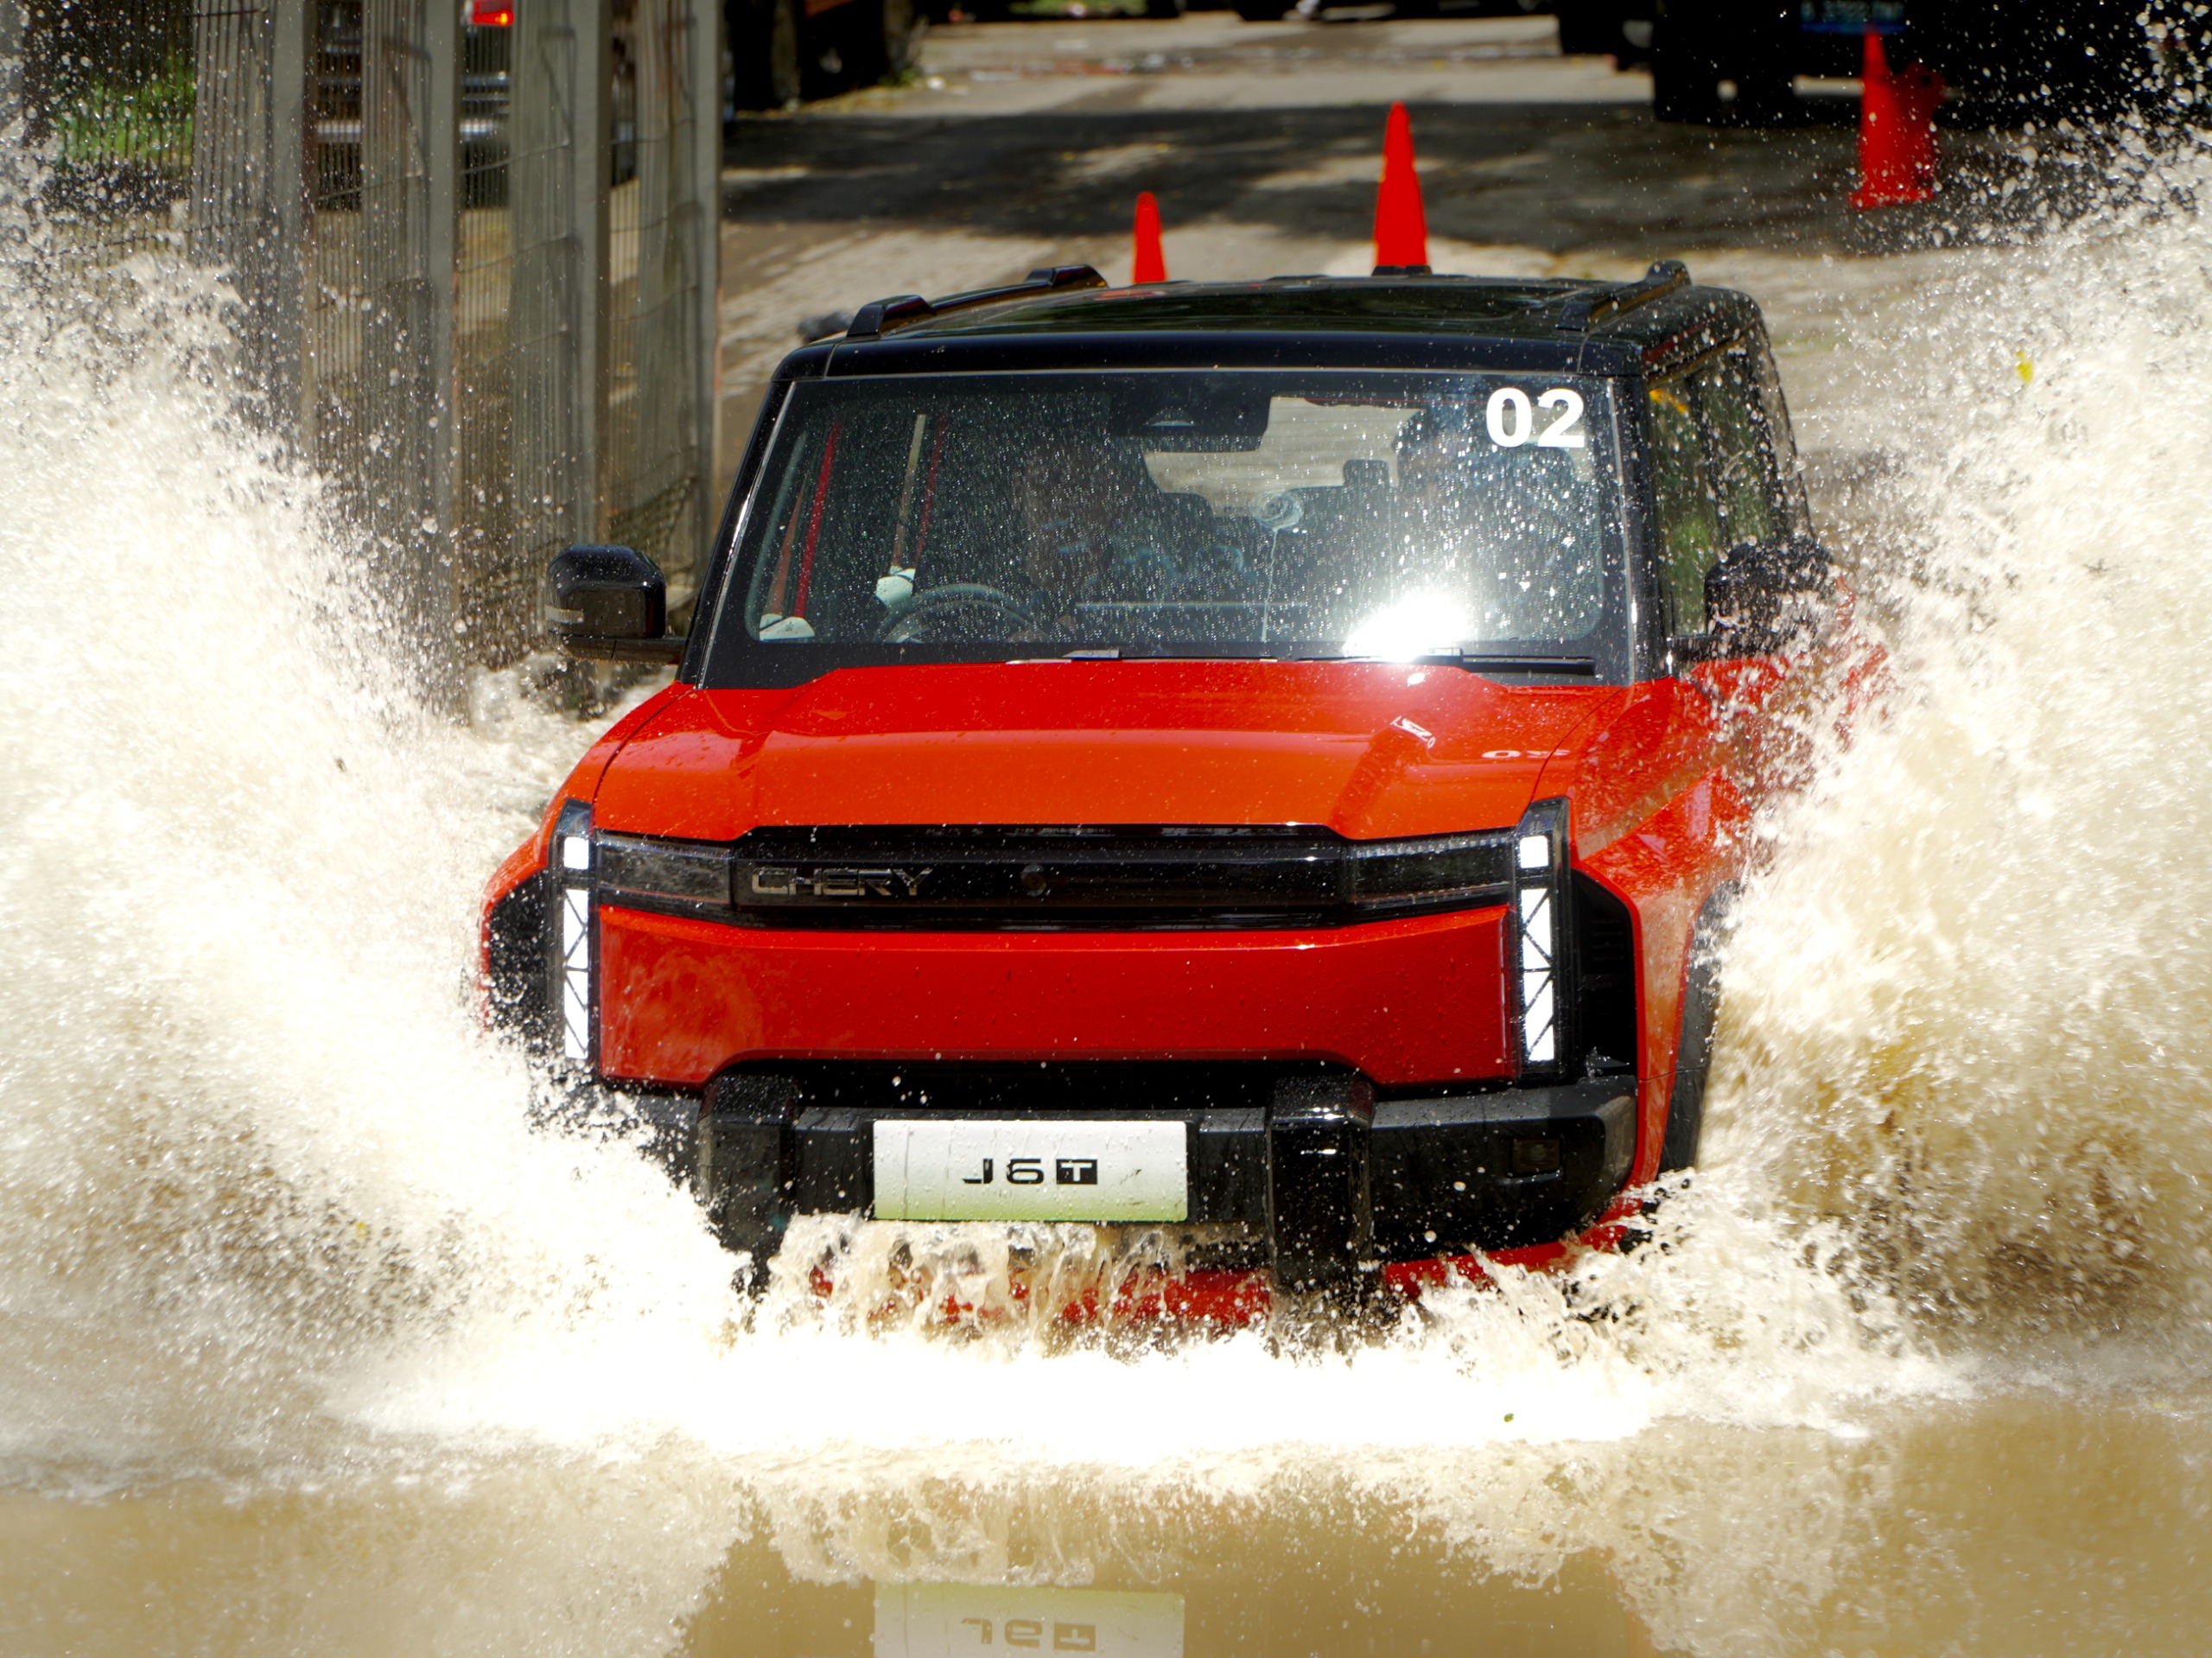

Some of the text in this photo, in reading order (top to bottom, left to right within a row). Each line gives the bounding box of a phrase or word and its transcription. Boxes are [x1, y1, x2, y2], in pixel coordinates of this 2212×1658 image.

[1486, 387, 1585, 448] 02
[752, 867, 932, 896] CHERY
[962, 1158, 1098, 1185] J6T
